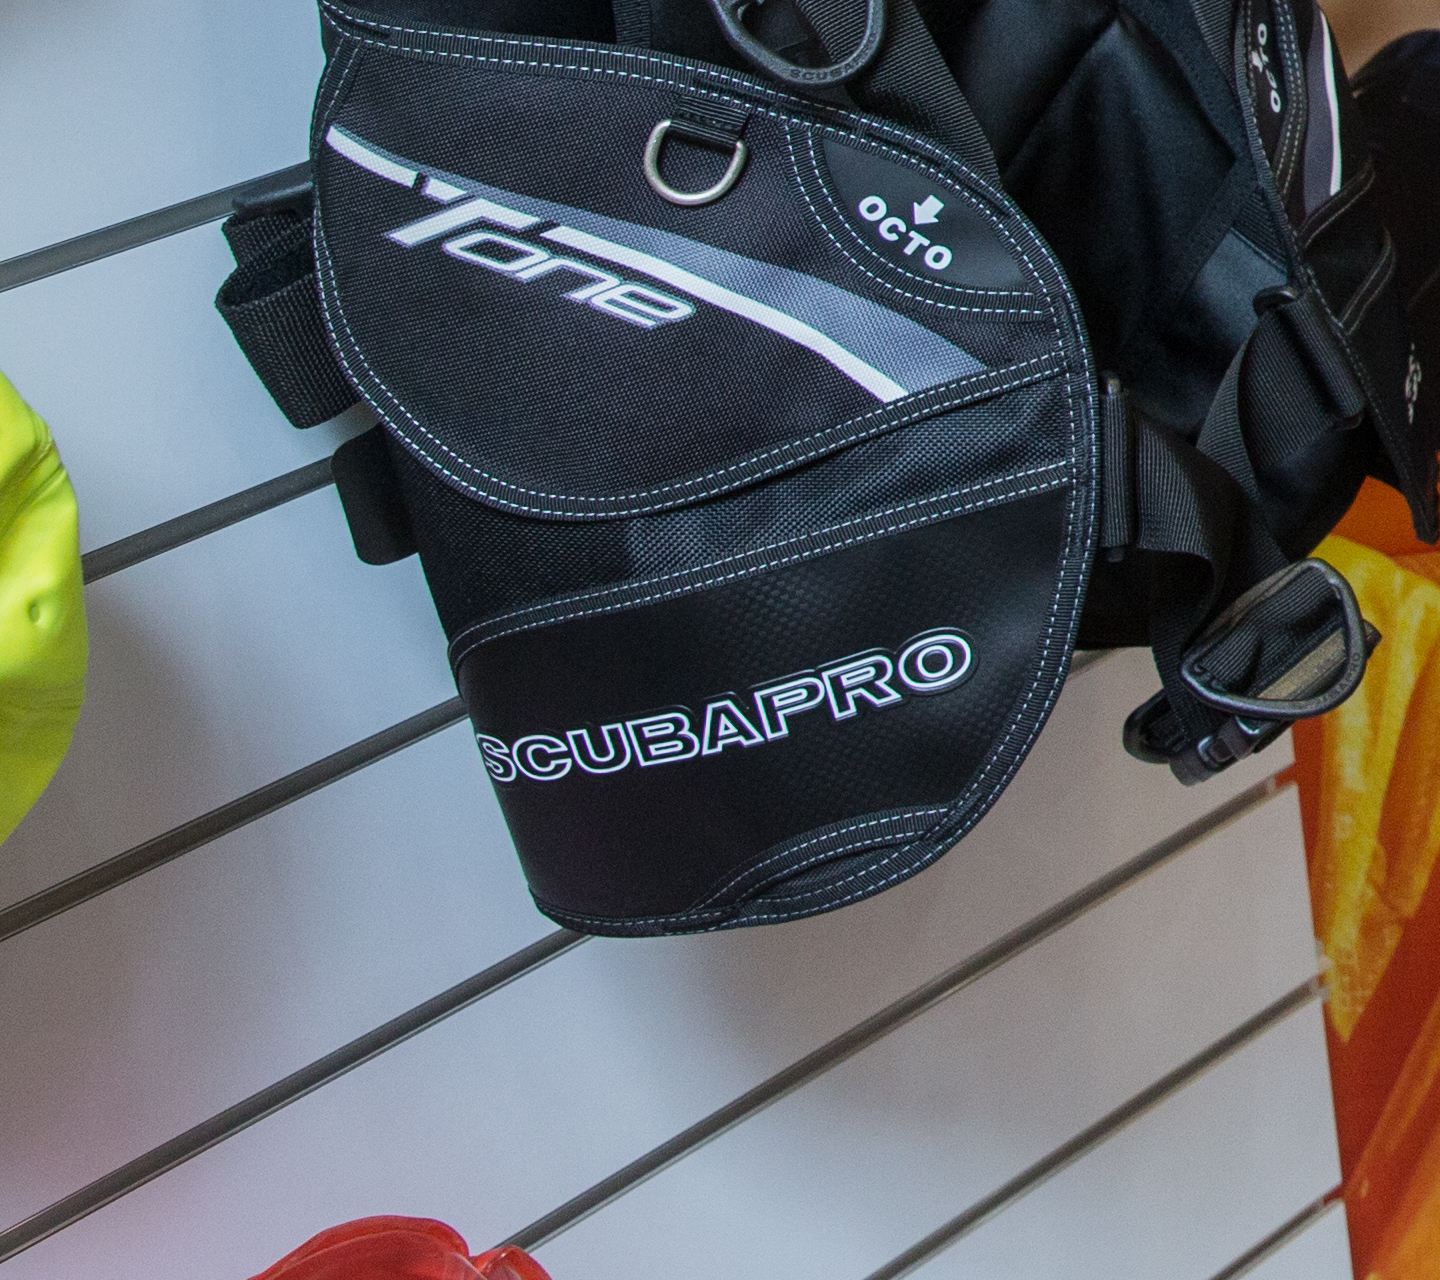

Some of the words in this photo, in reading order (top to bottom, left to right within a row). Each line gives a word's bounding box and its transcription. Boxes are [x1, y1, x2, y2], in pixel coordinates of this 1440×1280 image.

[384, 177, 697, 329] Tone
[858, 195, 953, 270] OCTO
[476, 633, 974, 783] SCUBAPRO
